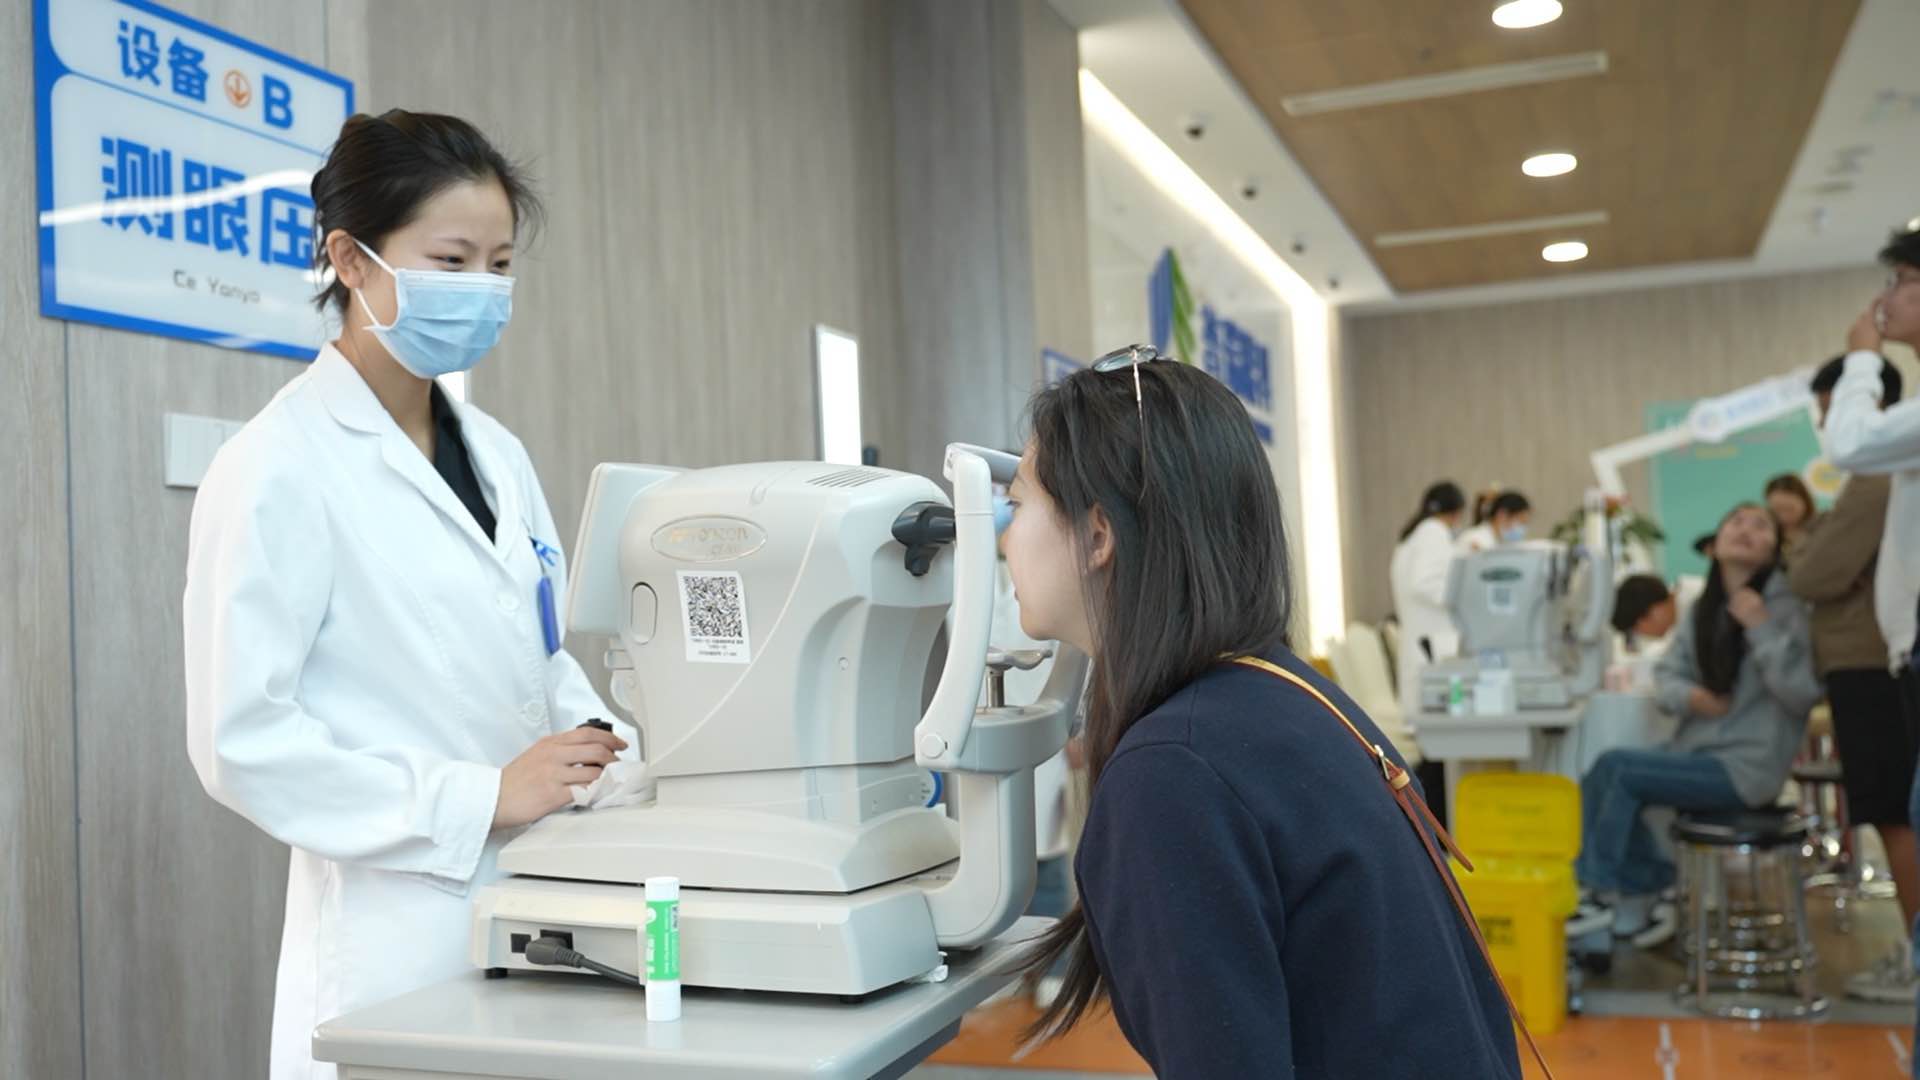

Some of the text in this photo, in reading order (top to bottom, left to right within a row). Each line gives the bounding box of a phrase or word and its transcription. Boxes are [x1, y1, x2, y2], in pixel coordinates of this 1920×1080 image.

[117, 20, 293, 129] 设备 B
[101, 137, 314, 270] 测眼压
[173, 269, 197, 290] Ce
